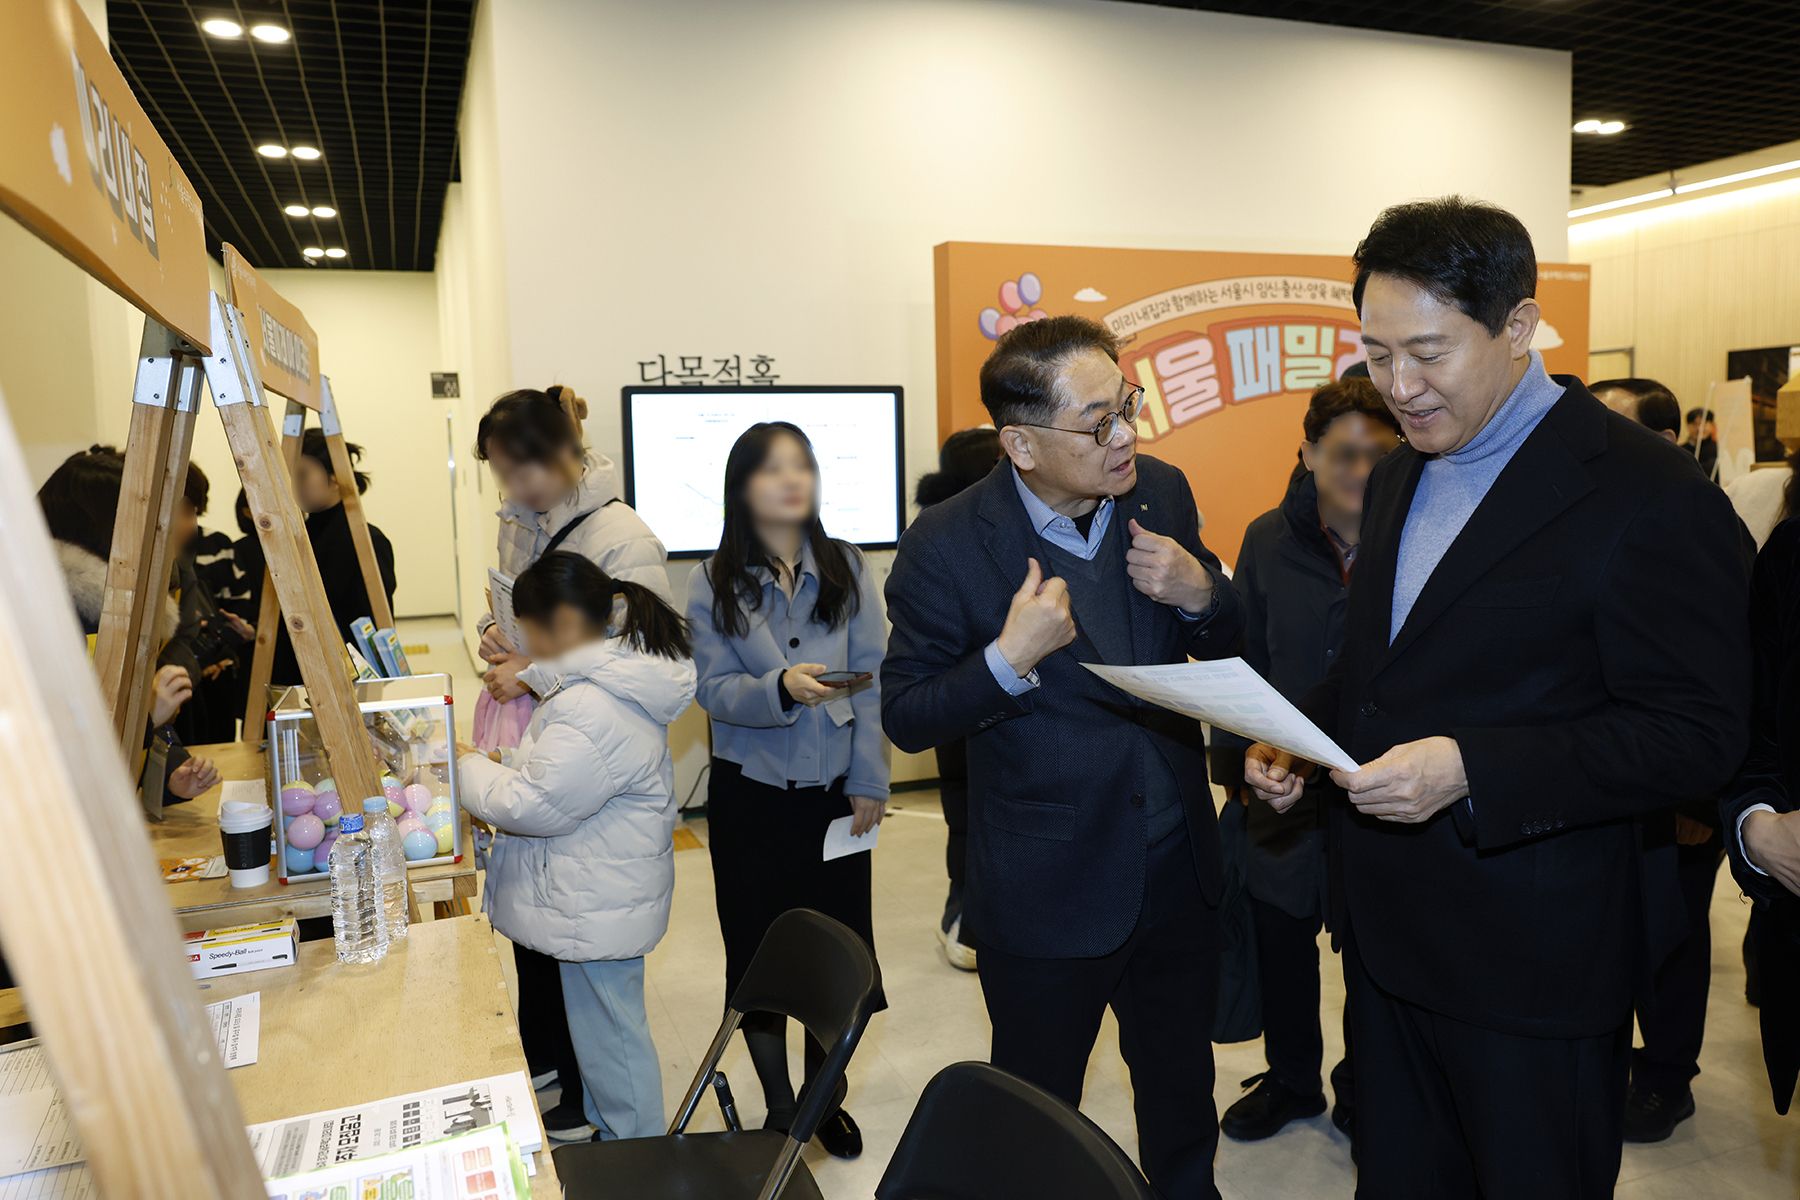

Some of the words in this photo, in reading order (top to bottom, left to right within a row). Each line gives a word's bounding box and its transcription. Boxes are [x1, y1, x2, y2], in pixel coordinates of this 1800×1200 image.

[1110, 299, 1171, 333] 미리내집과
[1171, 287, 1219, 313] 함께하는
[1221, 281, 1255, 301] 서울시
[208, 948, 248, 961] Speedy-Ball
[338, 1113, 362, 1146] 모집공고
